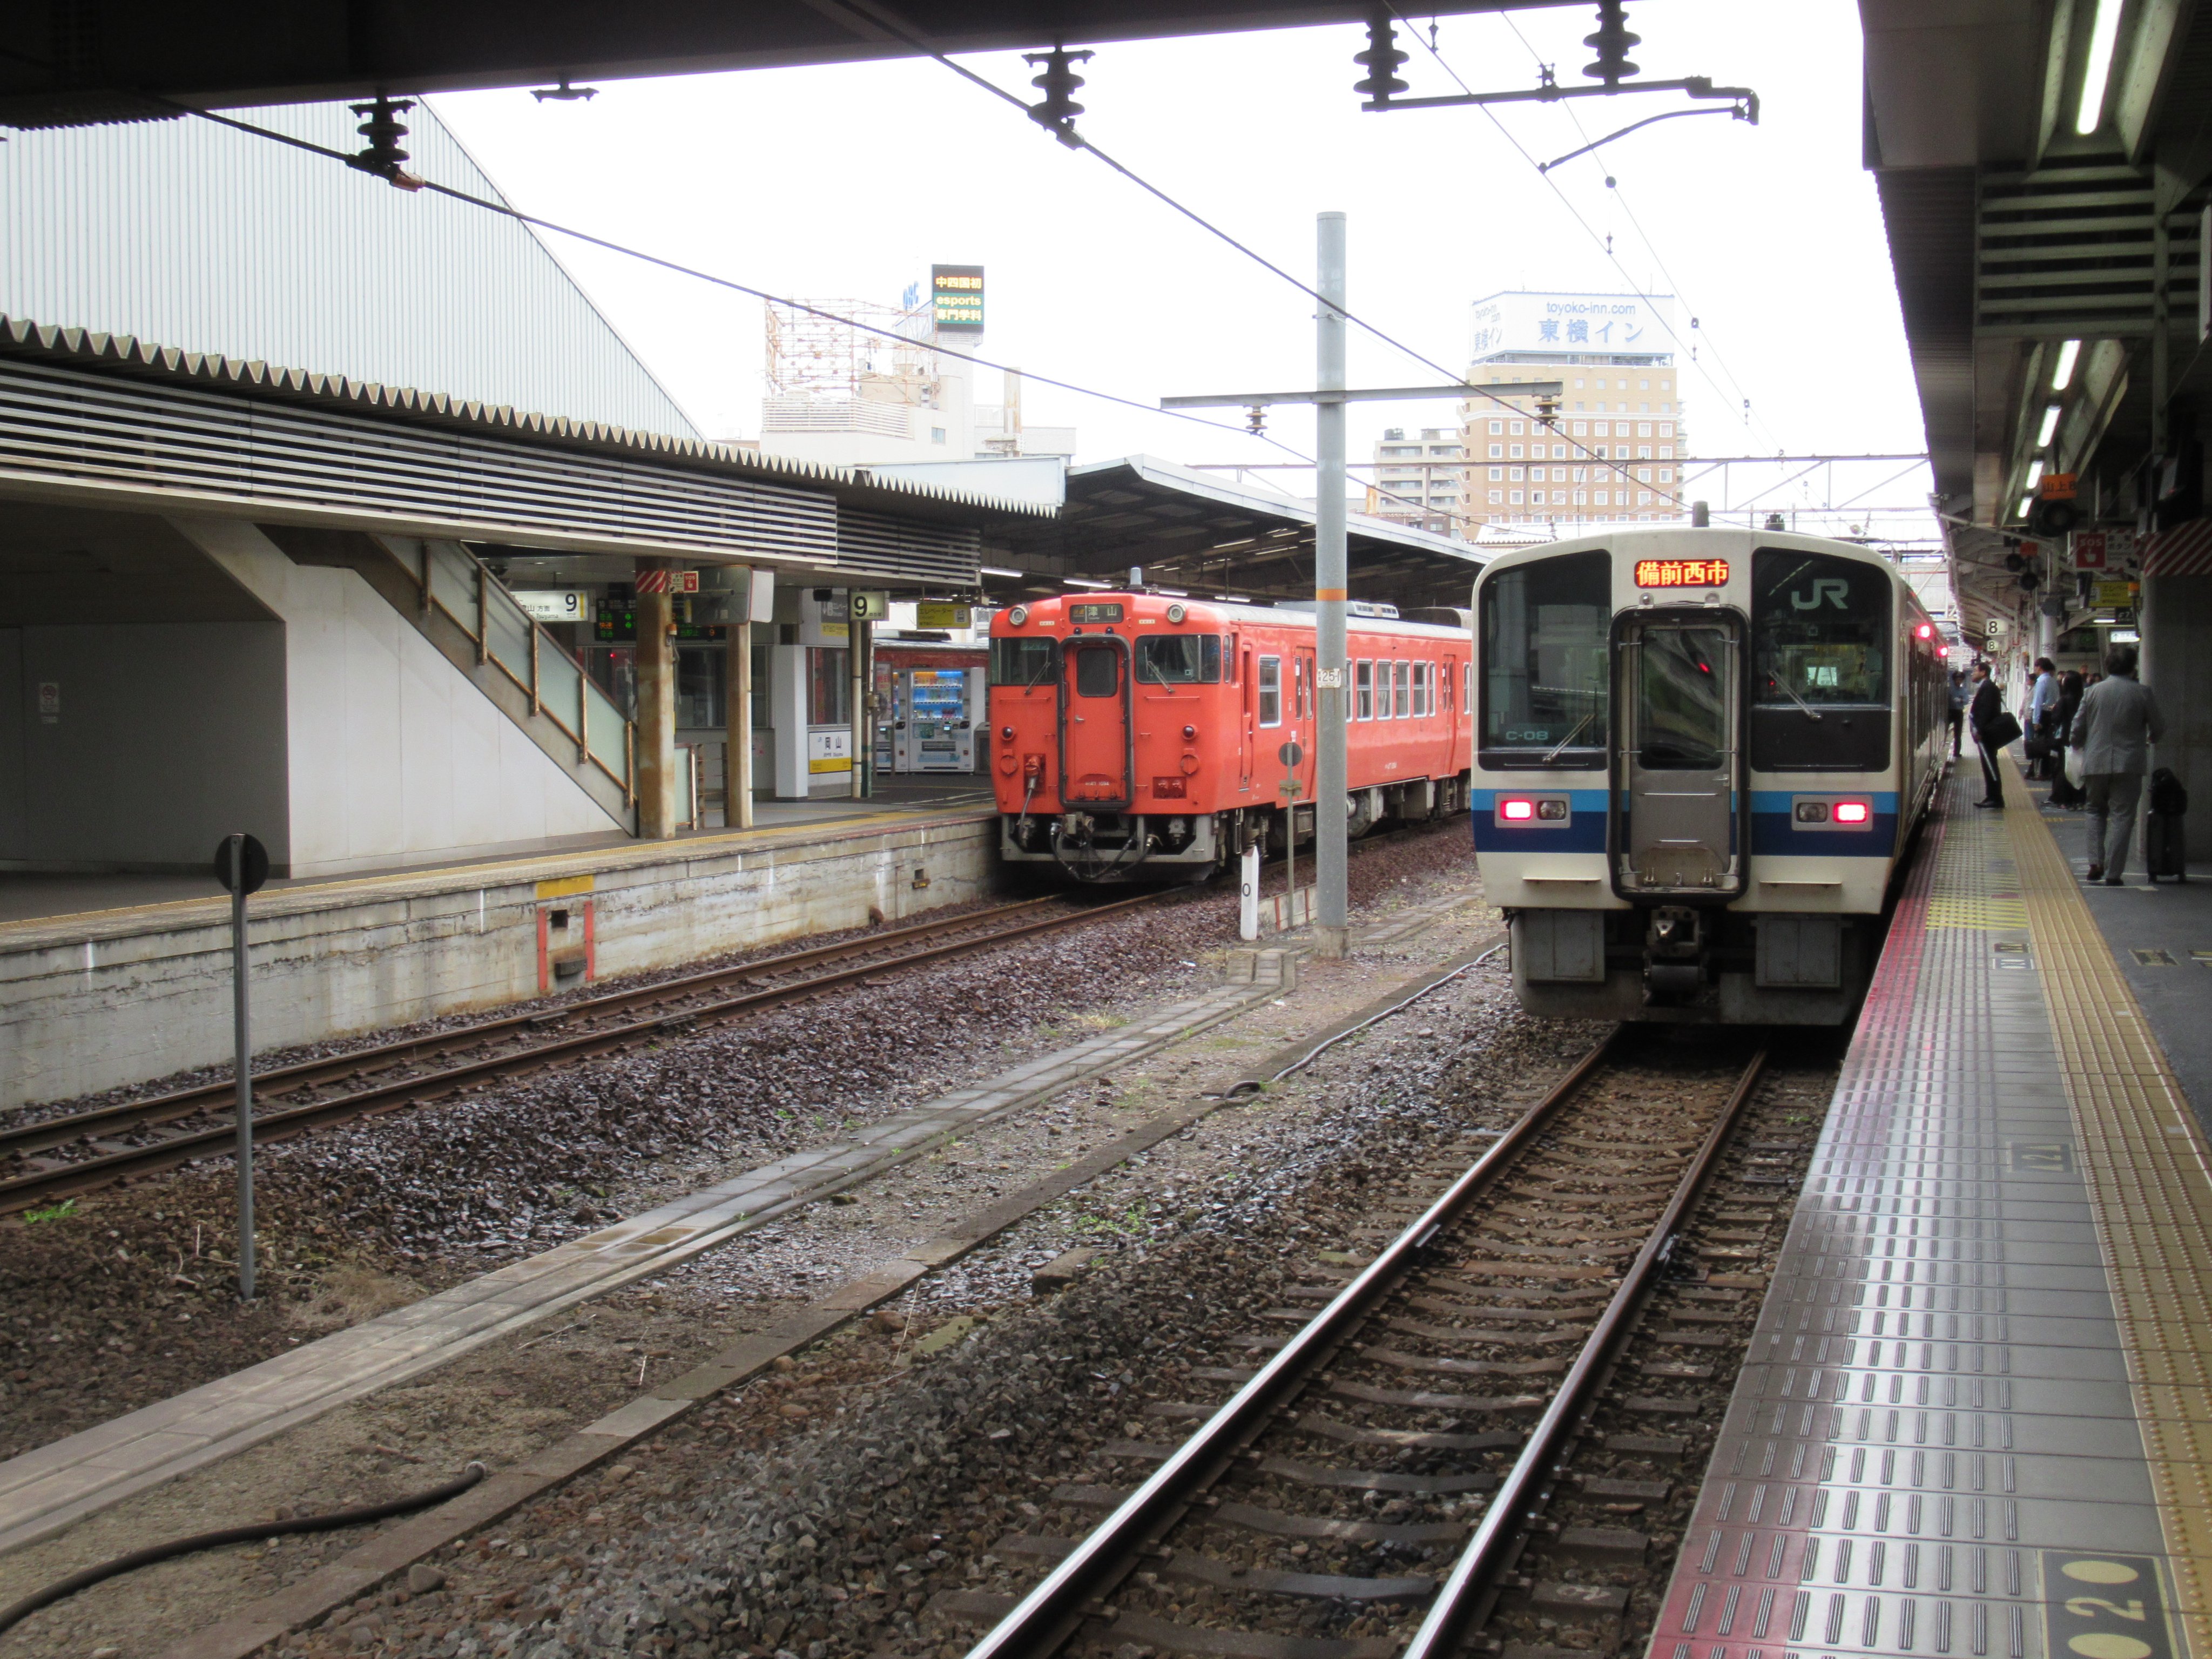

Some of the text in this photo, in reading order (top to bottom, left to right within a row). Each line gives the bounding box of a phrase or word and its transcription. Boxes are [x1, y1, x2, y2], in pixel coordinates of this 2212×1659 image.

[935, 276, 982, 289] 中四国初
[936, 295, 981, 307] esports
[1546, 301, 1636, 316] toyoko-inn.com
[1538, 318, 1643, 343] 東横イン
[1636, 560, 1729, 586] 備前西市
[1791, 579, 1848, 610] JR
[565, 593, 577, 612] 9
[854, 596, 867, 617] 9
[1989, 621, 1998, 633] 8
[1988, 641, 1995, 650] 8
[1505, 730, 1548, 741] C-08
[1243, 882, 1251, 897] 0
